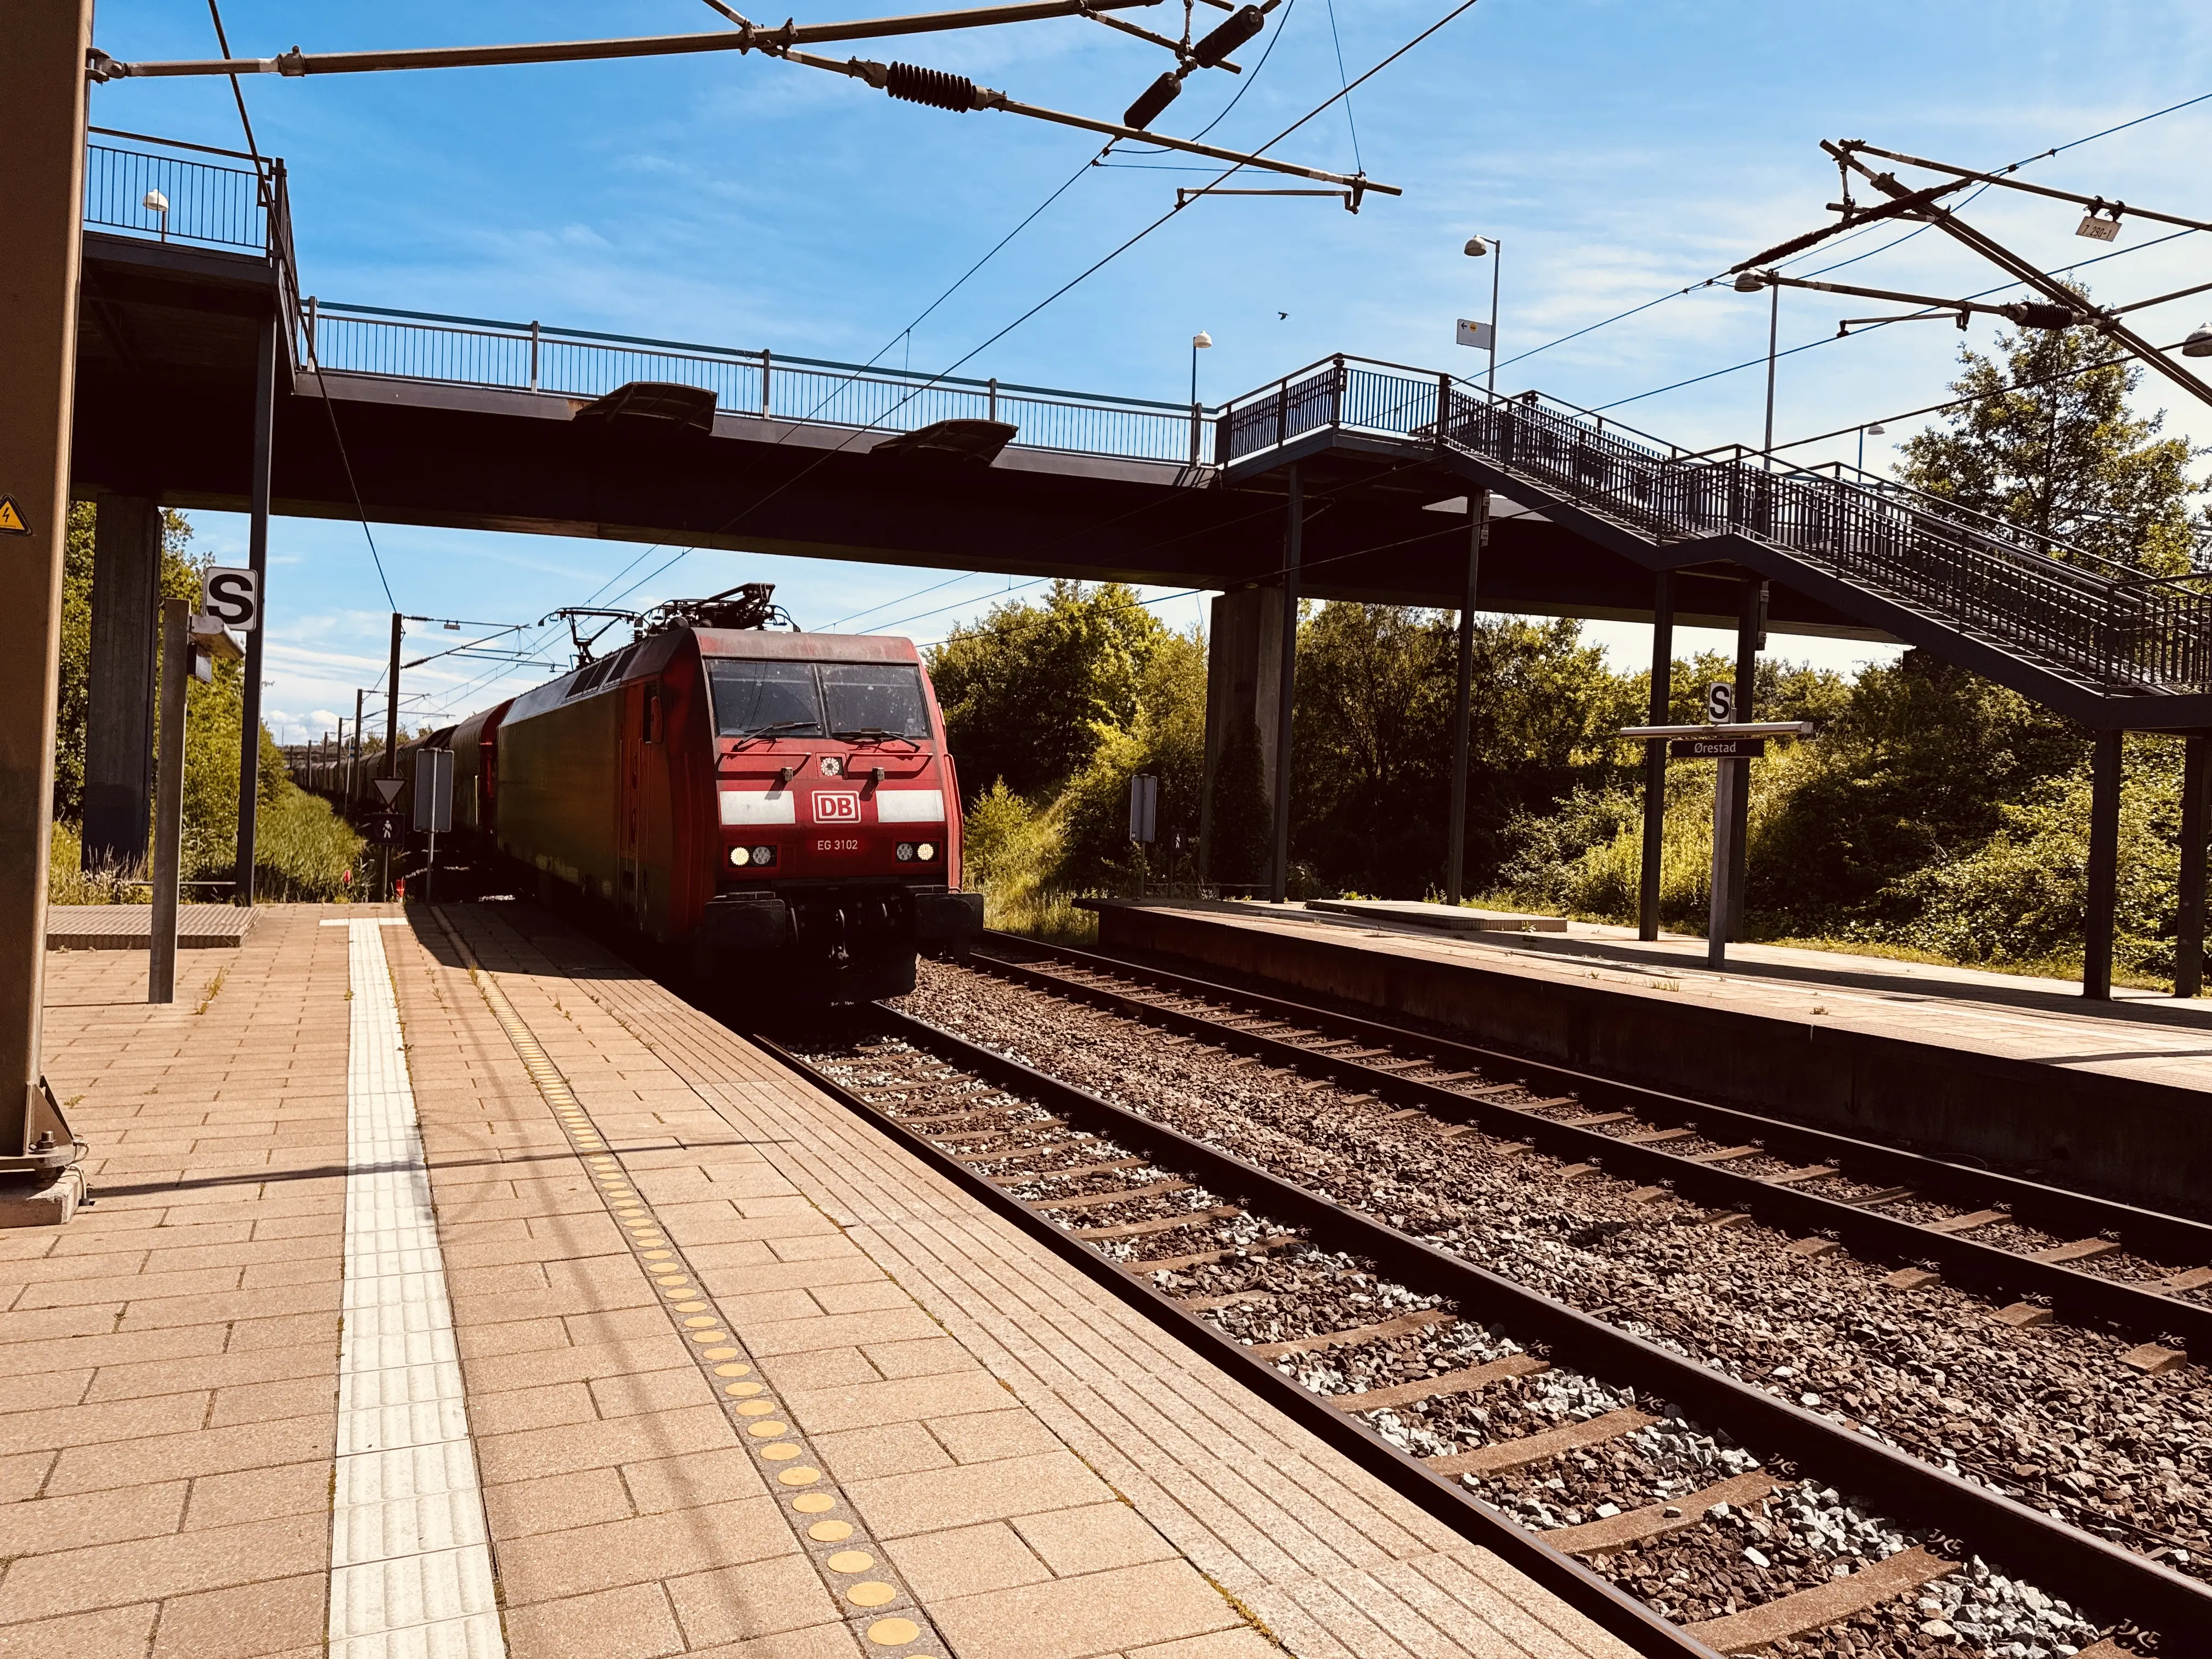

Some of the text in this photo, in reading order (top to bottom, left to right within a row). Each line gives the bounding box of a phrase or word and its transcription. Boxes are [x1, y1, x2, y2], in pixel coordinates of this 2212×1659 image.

[206, 574, 253, 624] S
[1709, 686, 1729, 719] S
[1694, 742, 1736, 753] Ørestad
[821, 798, 853, 816] DB
[817, 839, 858, 850] EG 3102
